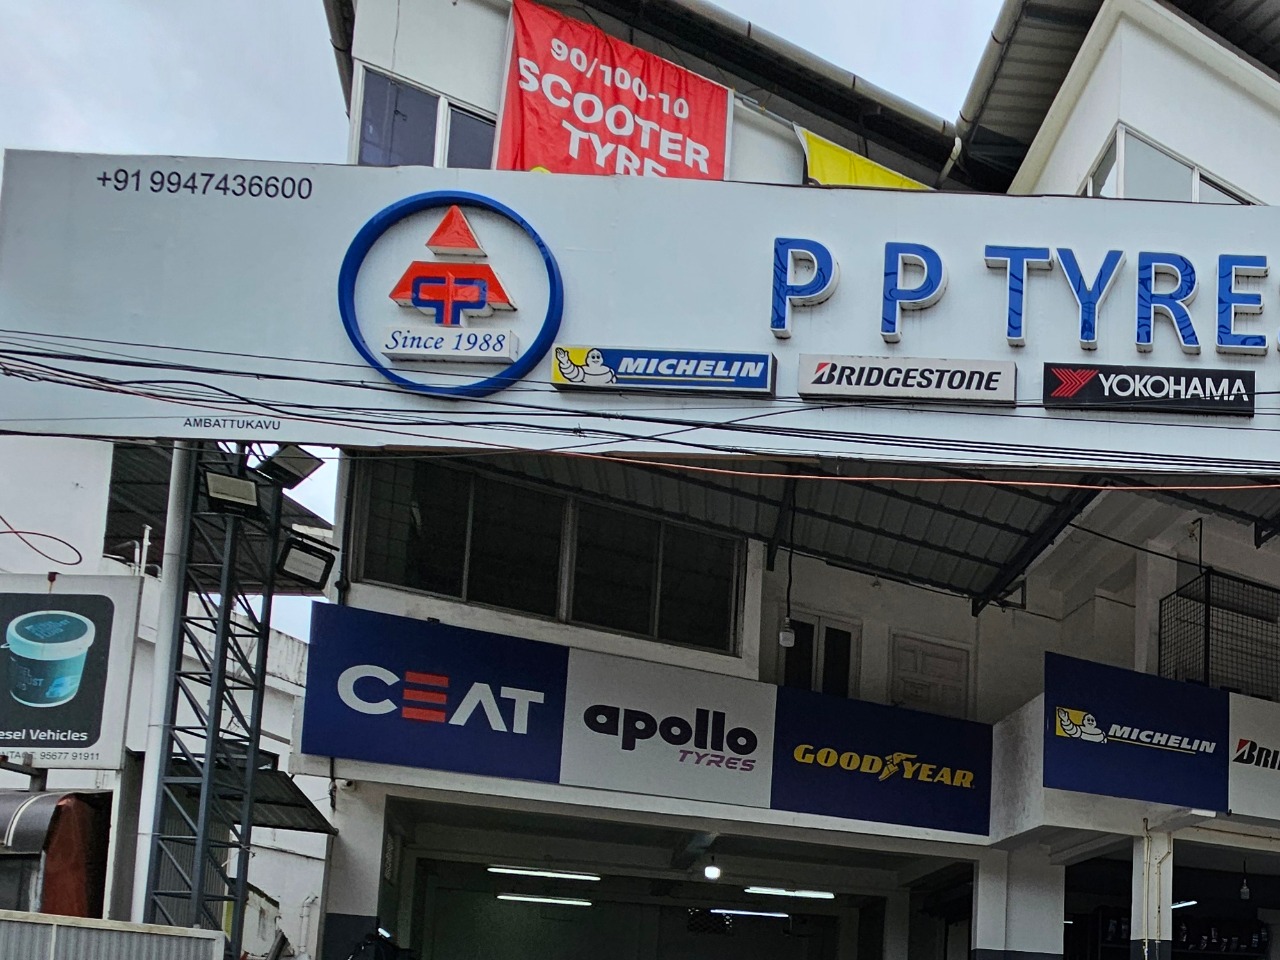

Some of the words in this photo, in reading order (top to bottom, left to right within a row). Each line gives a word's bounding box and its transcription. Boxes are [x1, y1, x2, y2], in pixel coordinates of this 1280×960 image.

[550, 38, 689, 119] 90/100-10
[518, 56, 710, 175] SCOOTER
[97, 168, 141, 192] +91
[150, 170, 313, 200] 9947436600
[771, 237, 839, 339] P
[881, 242, 947, 344] P
[385, 330, 444, 351] Since
[452, 333, 506, 353] 1988
[617, 356, 765, 379] MICHELIN
[810, 361, 1001, 392] BRIDGESTONE
[1098, 372, 1249, 402] YOKOHAMA
[183, 417, 281, 430] AMBATTUKAVU
[337, 664, 545, 735] CEAT
[29, 729, 88, 741] Vehicles
[583, 703, 759, 755] apollo
[1107, 723, 1217, 754] MICHELIN
[40, 751, 69, 760] 95677
[71, 752, 100, 760] 91911
[678, 749, 757, 773] TYRES
